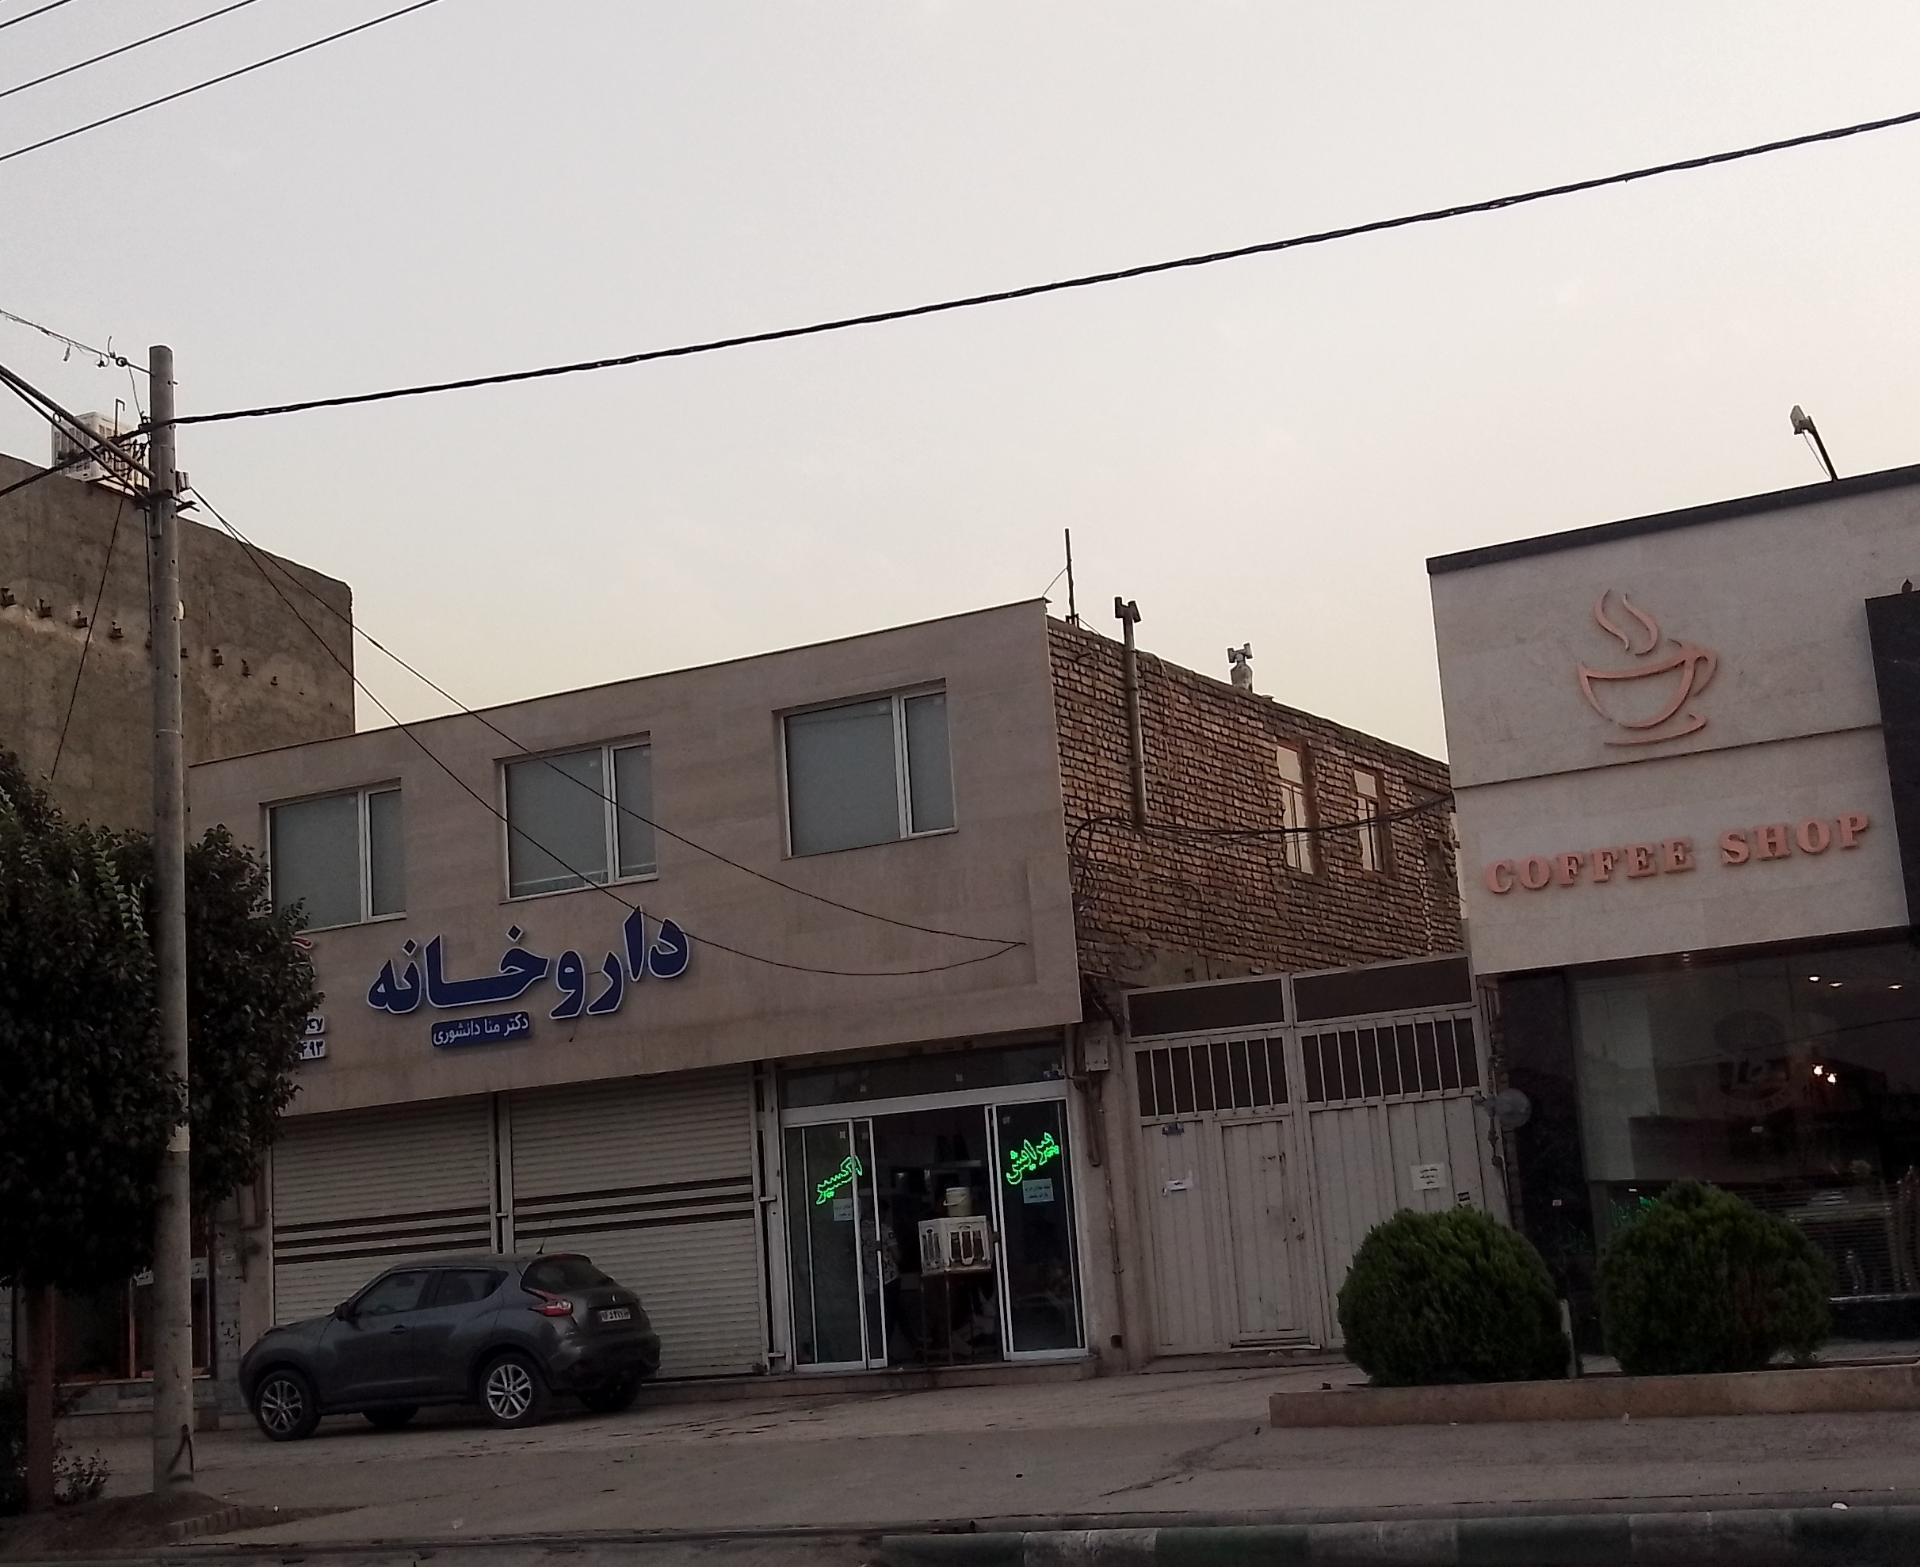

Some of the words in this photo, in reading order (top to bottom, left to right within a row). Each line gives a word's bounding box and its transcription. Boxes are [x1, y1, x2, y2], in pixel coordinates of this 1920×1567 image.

[1484, 838, 1695, 894] COFFEE
[1719, 812, 1870, 865] SHOP
[368, 905, 689, 1019] داروخانه
[433, 1020, 481, 1045] دانشوری
[503, 1013, 529, 1037] دکتر
